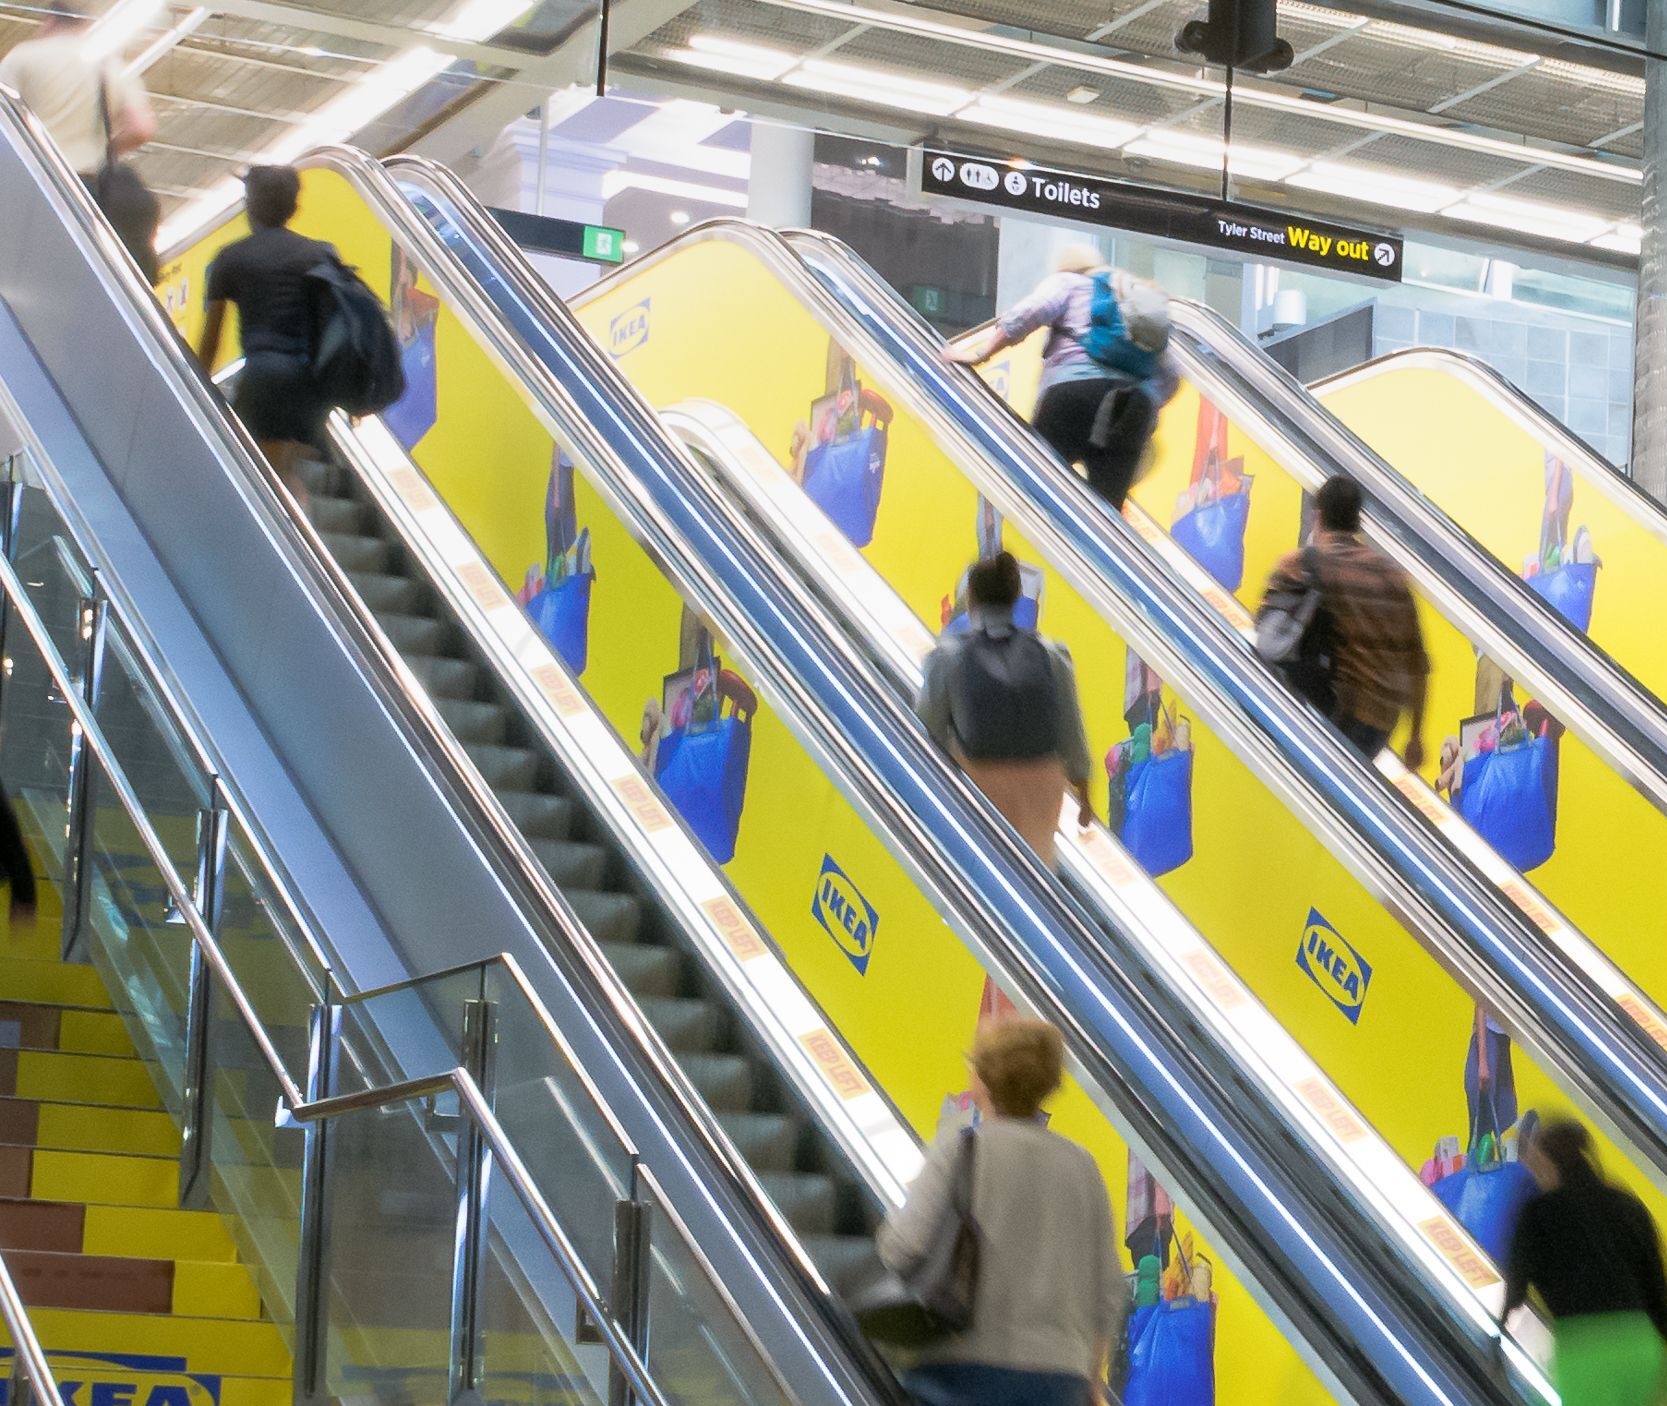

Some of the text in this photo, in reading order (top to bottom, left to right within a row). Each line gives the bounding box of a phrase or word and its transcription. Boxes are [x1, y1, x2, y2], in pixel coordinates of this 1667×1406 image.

[1031, 177, 1101, 209] Toilets
[1218, 219, 1370, 261] Tyler Street Way out
[612, 314, 646, 348] IKEA
[821, 877, 869, 951] IKEA
[1307, 930, 1361, 1001] IKEA
[1427, 1220, 1490, 1280] KEEP LEFT
